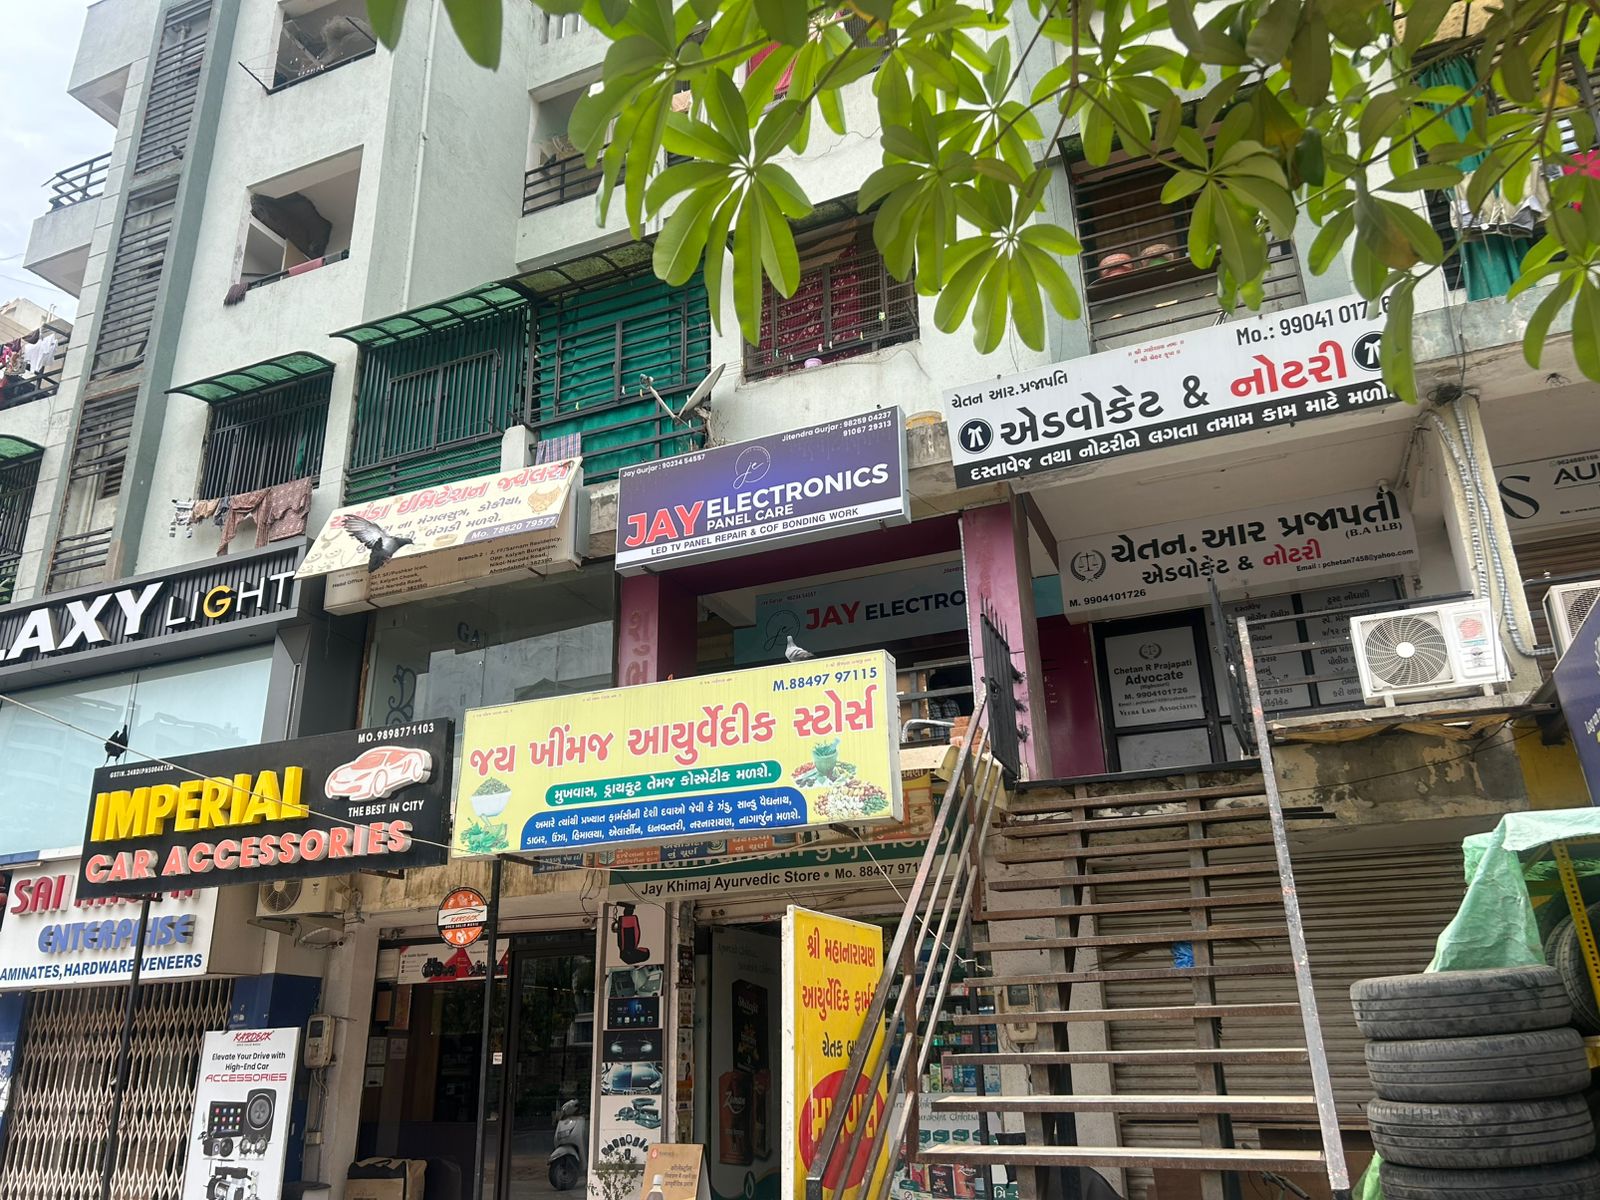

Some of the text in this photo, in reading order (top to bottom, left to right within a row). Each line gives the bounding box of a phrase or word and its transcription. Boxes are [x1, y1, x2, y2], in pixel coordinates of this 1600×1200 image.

[1280, 309, 1333, 336] 99041
[1339, 296, 1390, 323] 0176
[951, 391, 984, 409] ચેતન
[1000, 340, 1347, 447] એડવોકેટ & નોટરી
[782, 428, 813, 443] Jitendra
[815, 422, 839, 435] Gurjar
[970, 457, 1032, 481] દસ્તાવેજ
[1040, 449, 1072, 467] તથા
[1078, 430, 1142, 459] નોટરીને
[1149, 421, 1199, 444] લગતા
[1206, 410, 1254, 433] તમામ
[1262, 403, 1297, 424] કામ
[1305, 391, 1340, 413] માટે
[623, 469, 635, 478] Jay
[636, 464, 658, 475] Gurjar
[625, 463, 889, 547] JAY ELECTRONICS
[707, 504, 794, 531] PANEL CARE
[472, 516, 556, 540] Mo. 78620 79577
[651, 507, 859, 556] LED TV PANEL REPAIR & COF BONDING WORK
[1142, 538, 1323, 585] એડવોકેટ & નોટરી
[1296, 562, 1316, 573] Email
[347, 578, 365, 587] Office
[1083, 588, 1147, 606] 9904101726
[0, 571, 296, 660] AXY LIGHT
[806, 601, 861, 631] JAY
[773, 667, 879, 692] M.88497 97115
[1114, 659, 1193, 676] Chetan R Prajapati
[1125, 670, 1184, 686] Advocate
[358, 722, 435, 744] MO.9898771103
[470, 684, 878, 777] જય ખીંમજ આયુર્વેદીક સ્ટોર્સ
[554, 786, 598, 804] મુખવાસ,
[647, 775, 676, 791] તેમજ
[736, 764, 772, 780] મળશે.
[91, 766, 309, 842] IMPERIAL
[348, 800, 424, 818] THE BEST IN CITY
[643, 805, 658, 818] દેશી
[688, 801, 704, 813] જેવી
[707, 800, 714, 811] કે
[526, 834, 548, 846] ડાબર,
[776, 808, 801, 822] મળશે.
[85, 819, 414, 884] CAR ACCESSORIES
[642, 864, 893, 897] Jay Khimaj Ayurvedic Store Mo. 88497
[10, 875, 74, 915] SAI
[807, 927, 876, 968] શ્રી મહાનારાયણ
[140, 953, 203, 972] VENEERS
[212, 1051, 286, 1061] Elevate Your Drive with
[225, 1062, 270, 1073] High-End Car
[205, 1073, 288, 1083] ACCESSORIES
